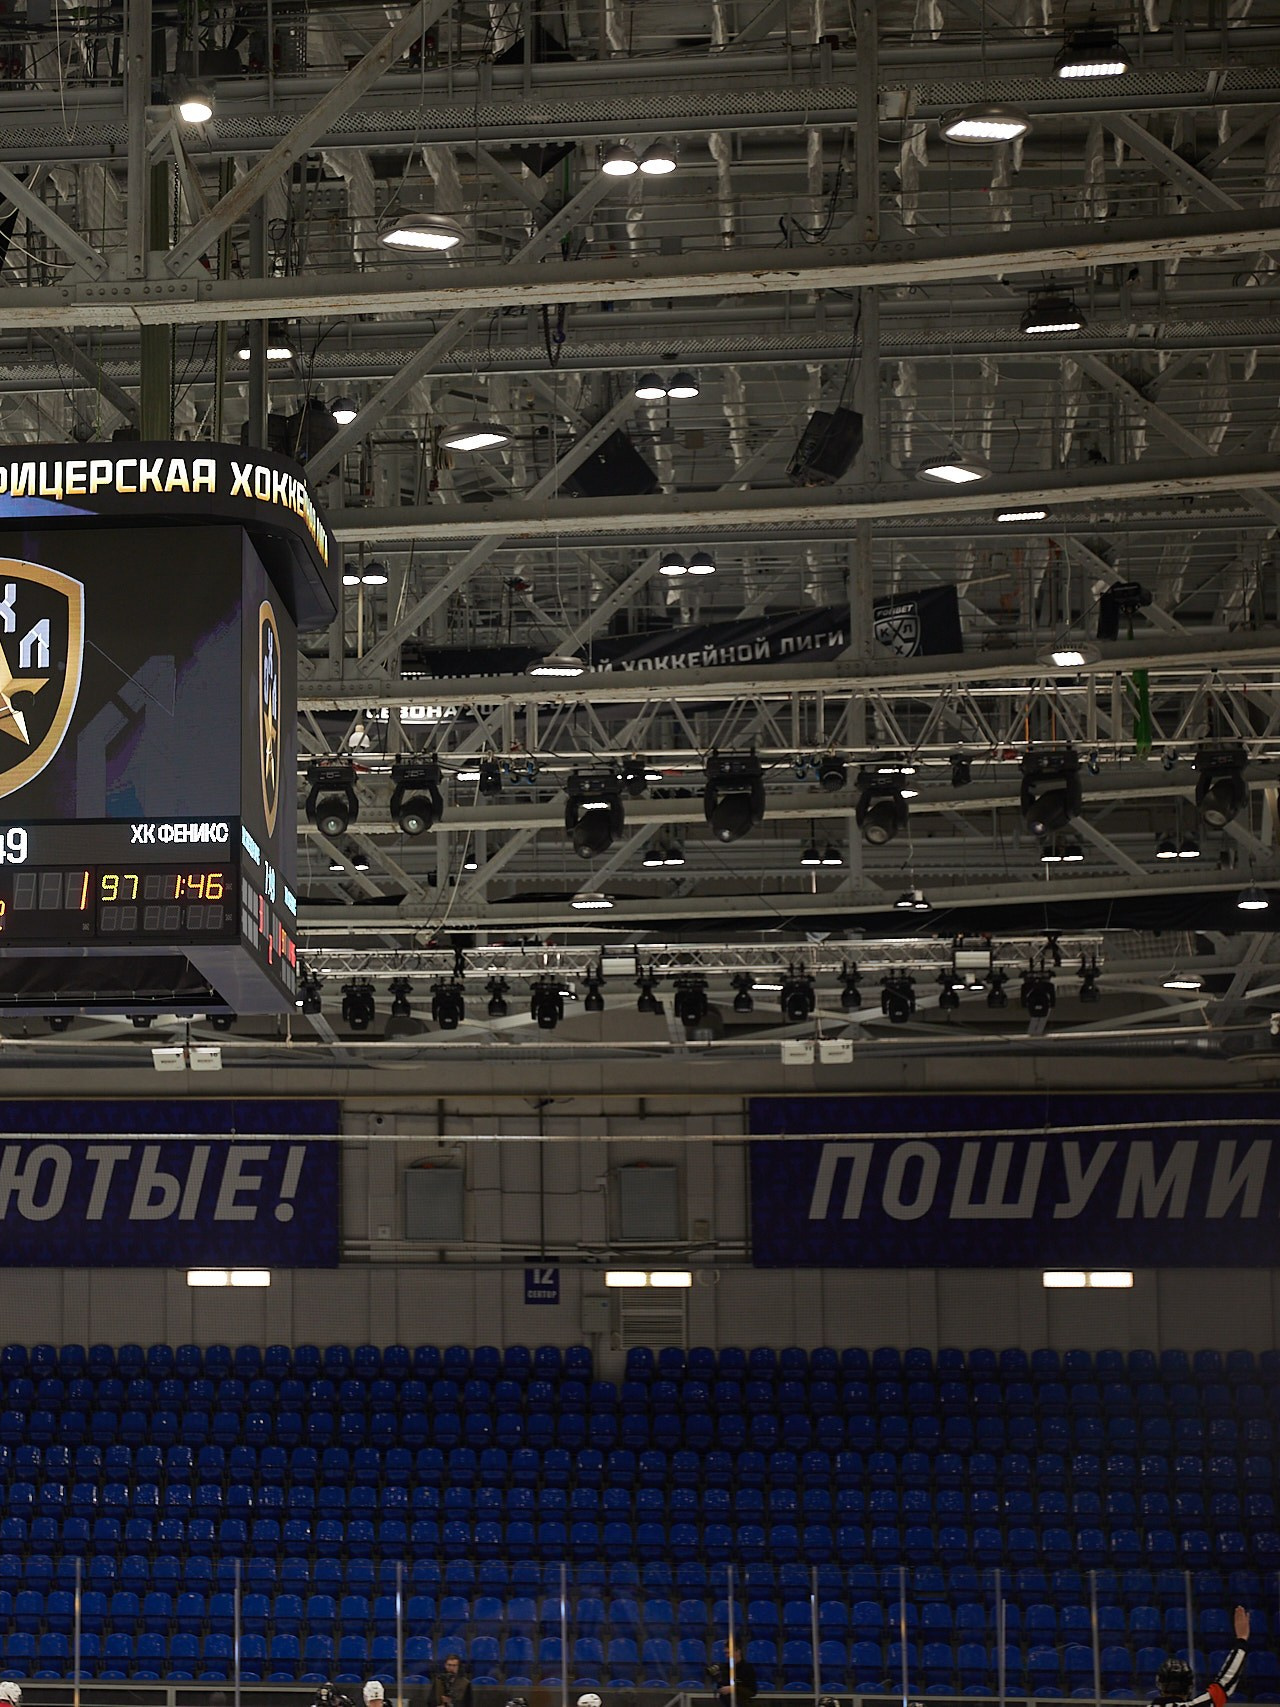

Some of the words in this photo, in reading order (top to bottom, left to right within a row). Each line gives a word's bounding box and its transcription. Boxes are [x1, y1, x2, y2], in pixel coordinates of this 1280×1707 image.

[622, 637, 770, 673] ХОККЕЙНОЙ
[779, 629, 845, 655] ЛИГИ
[130, 823, 156, 844] ХК
[158, 822, 229, 843] ФЕНИКС
[79, 870, 90, 911] 1
[101, 873, 139, 902] 97
[174, 872, 224, 900] 1:46
[808, 1139, 1280, 1221] ПОШУМИ
[533, 1268, 554, 1284] 12
